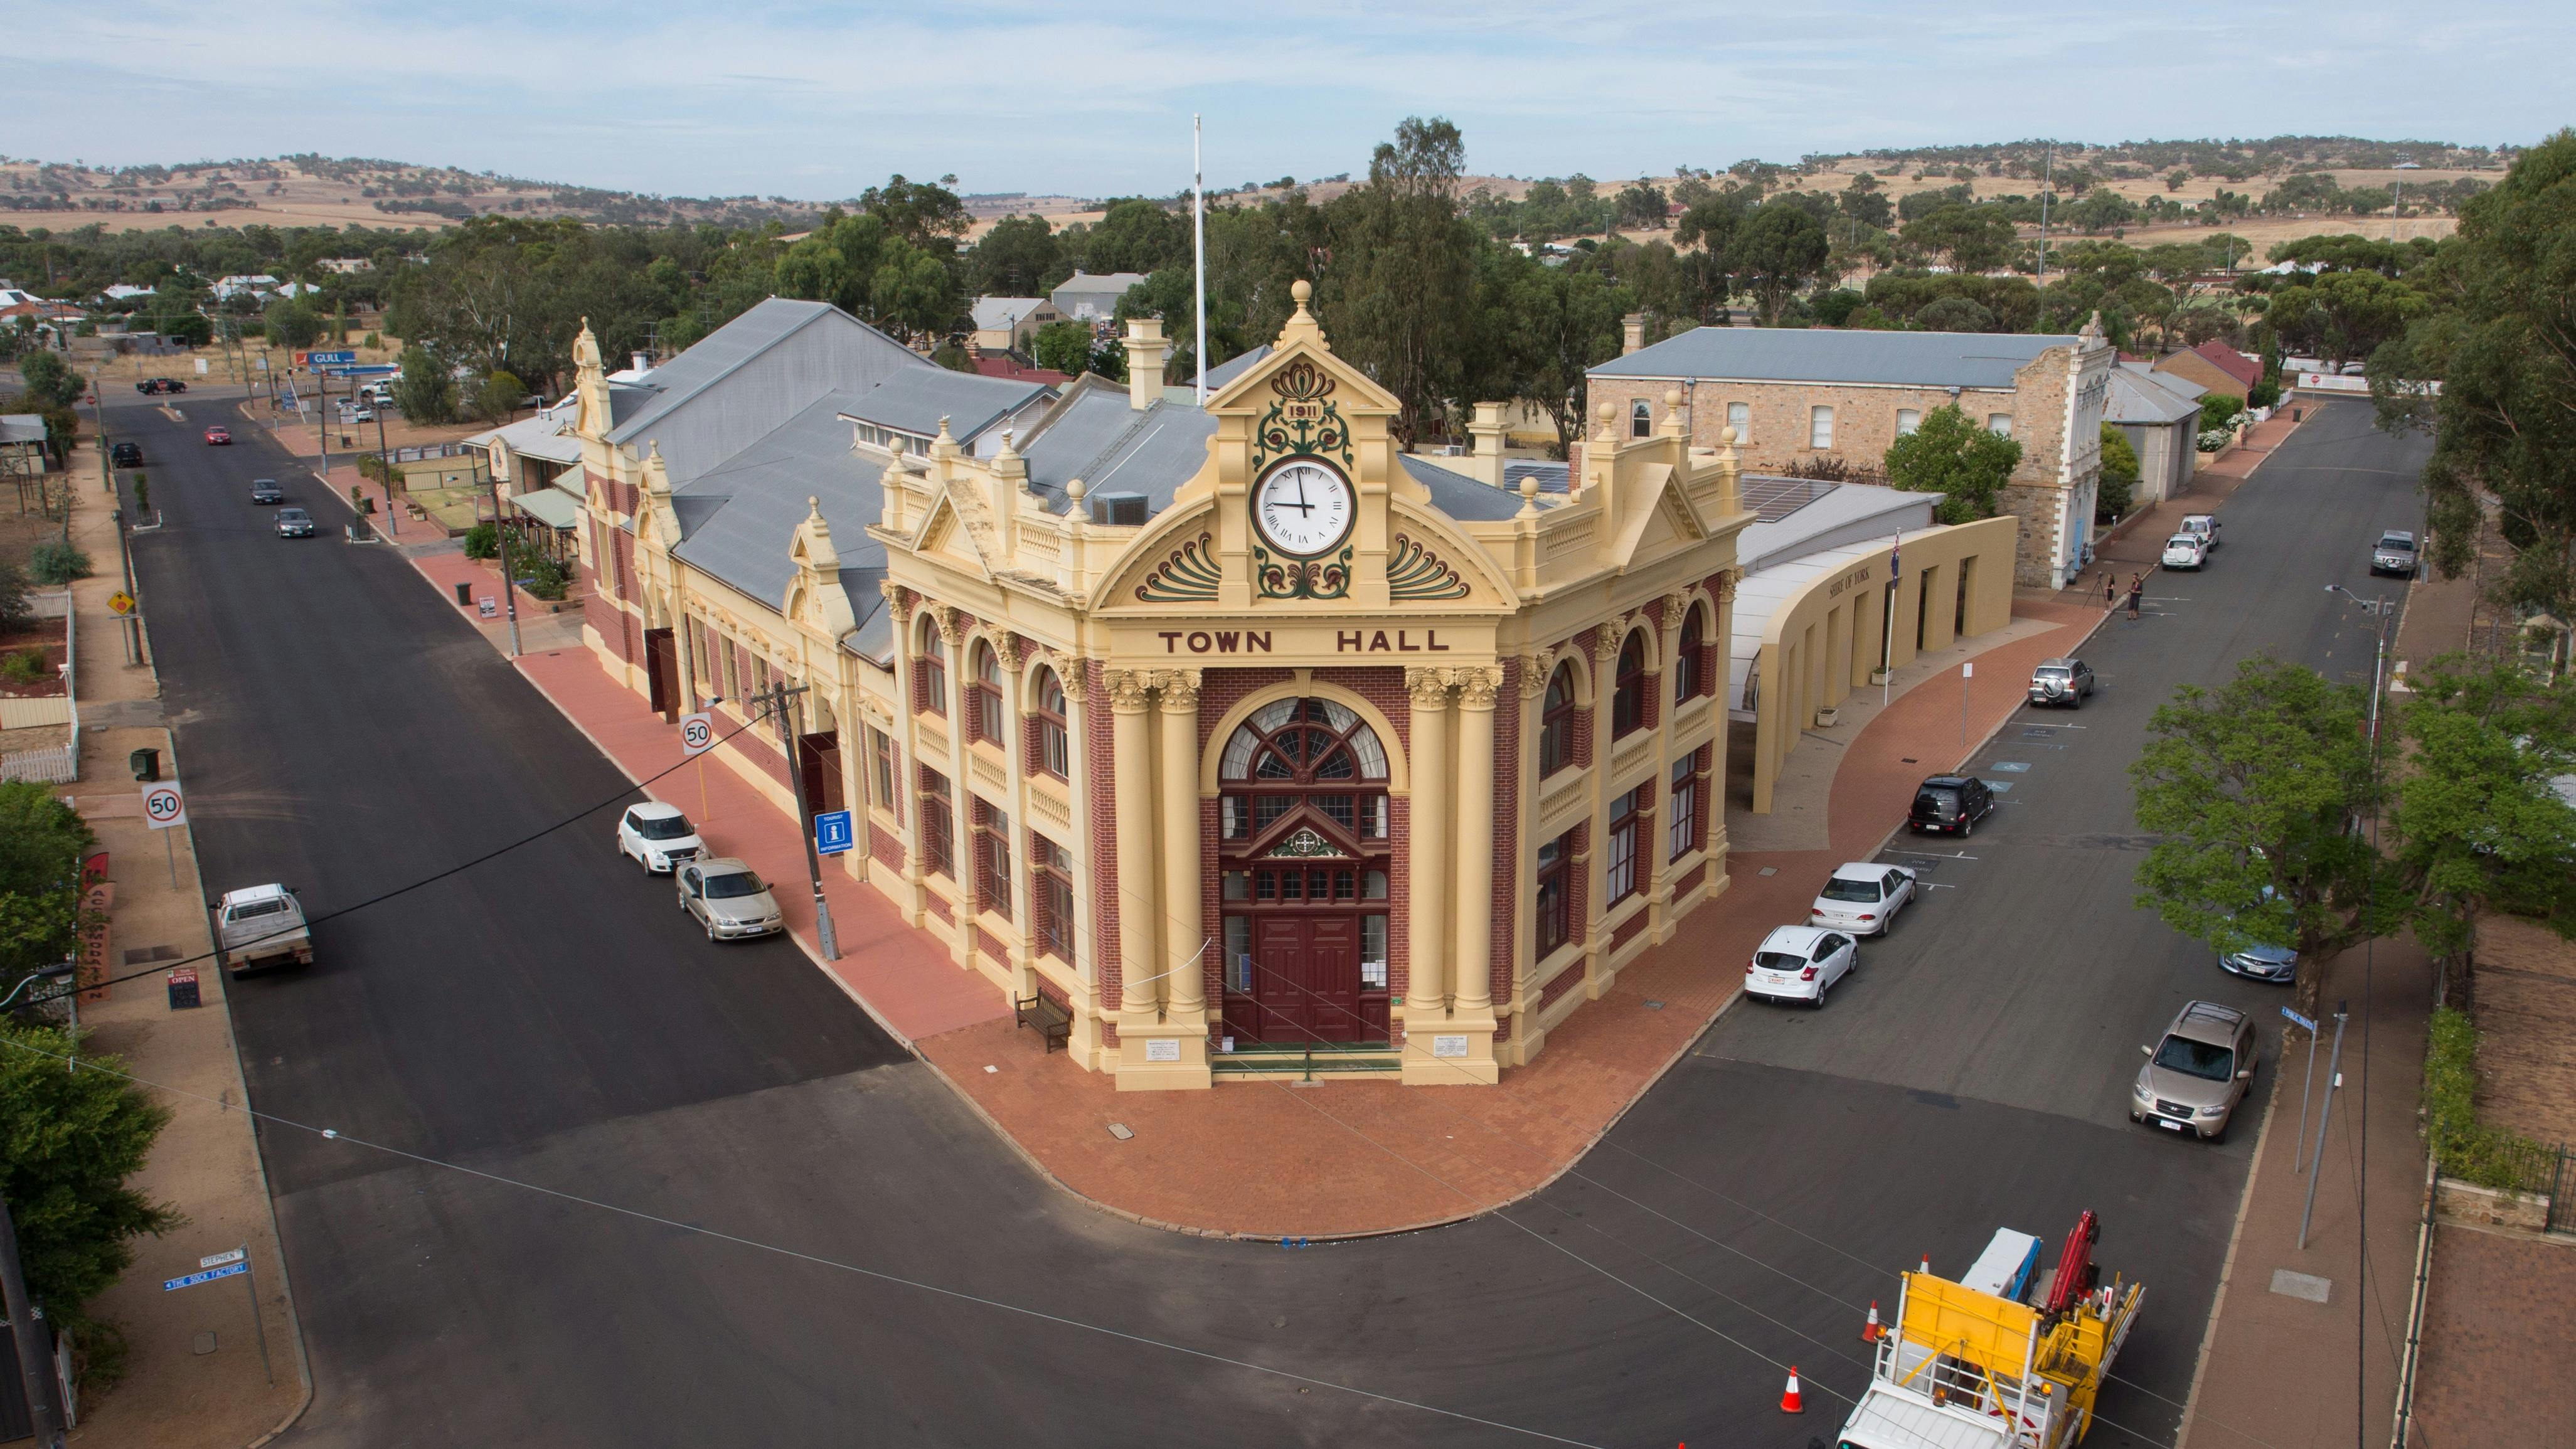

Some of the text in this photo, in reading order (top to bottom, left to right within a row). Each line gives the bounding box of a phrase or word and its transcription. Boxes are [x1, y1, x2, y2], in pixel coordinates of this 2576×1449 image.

[315, 354, 341, 362] GULL
[1290, 406, 1316, 417] 1911
[1829, 566, 1870, 600] SHIRE OF YORK
[1158, 630, 1449, 653] TOWN HALL
[687, 726, 708, 741] 50
[151, 796, 176, 814] 50
[824, 814, 843, 822] TOURIST
[820, 842, 851, 852] INFORMATION
[172, 975, 195, 984] OPEN
[202, 1253, 235, 1266] STEPHEN
[173, 1263, 244, 1290] THE SOCK FACTORY
